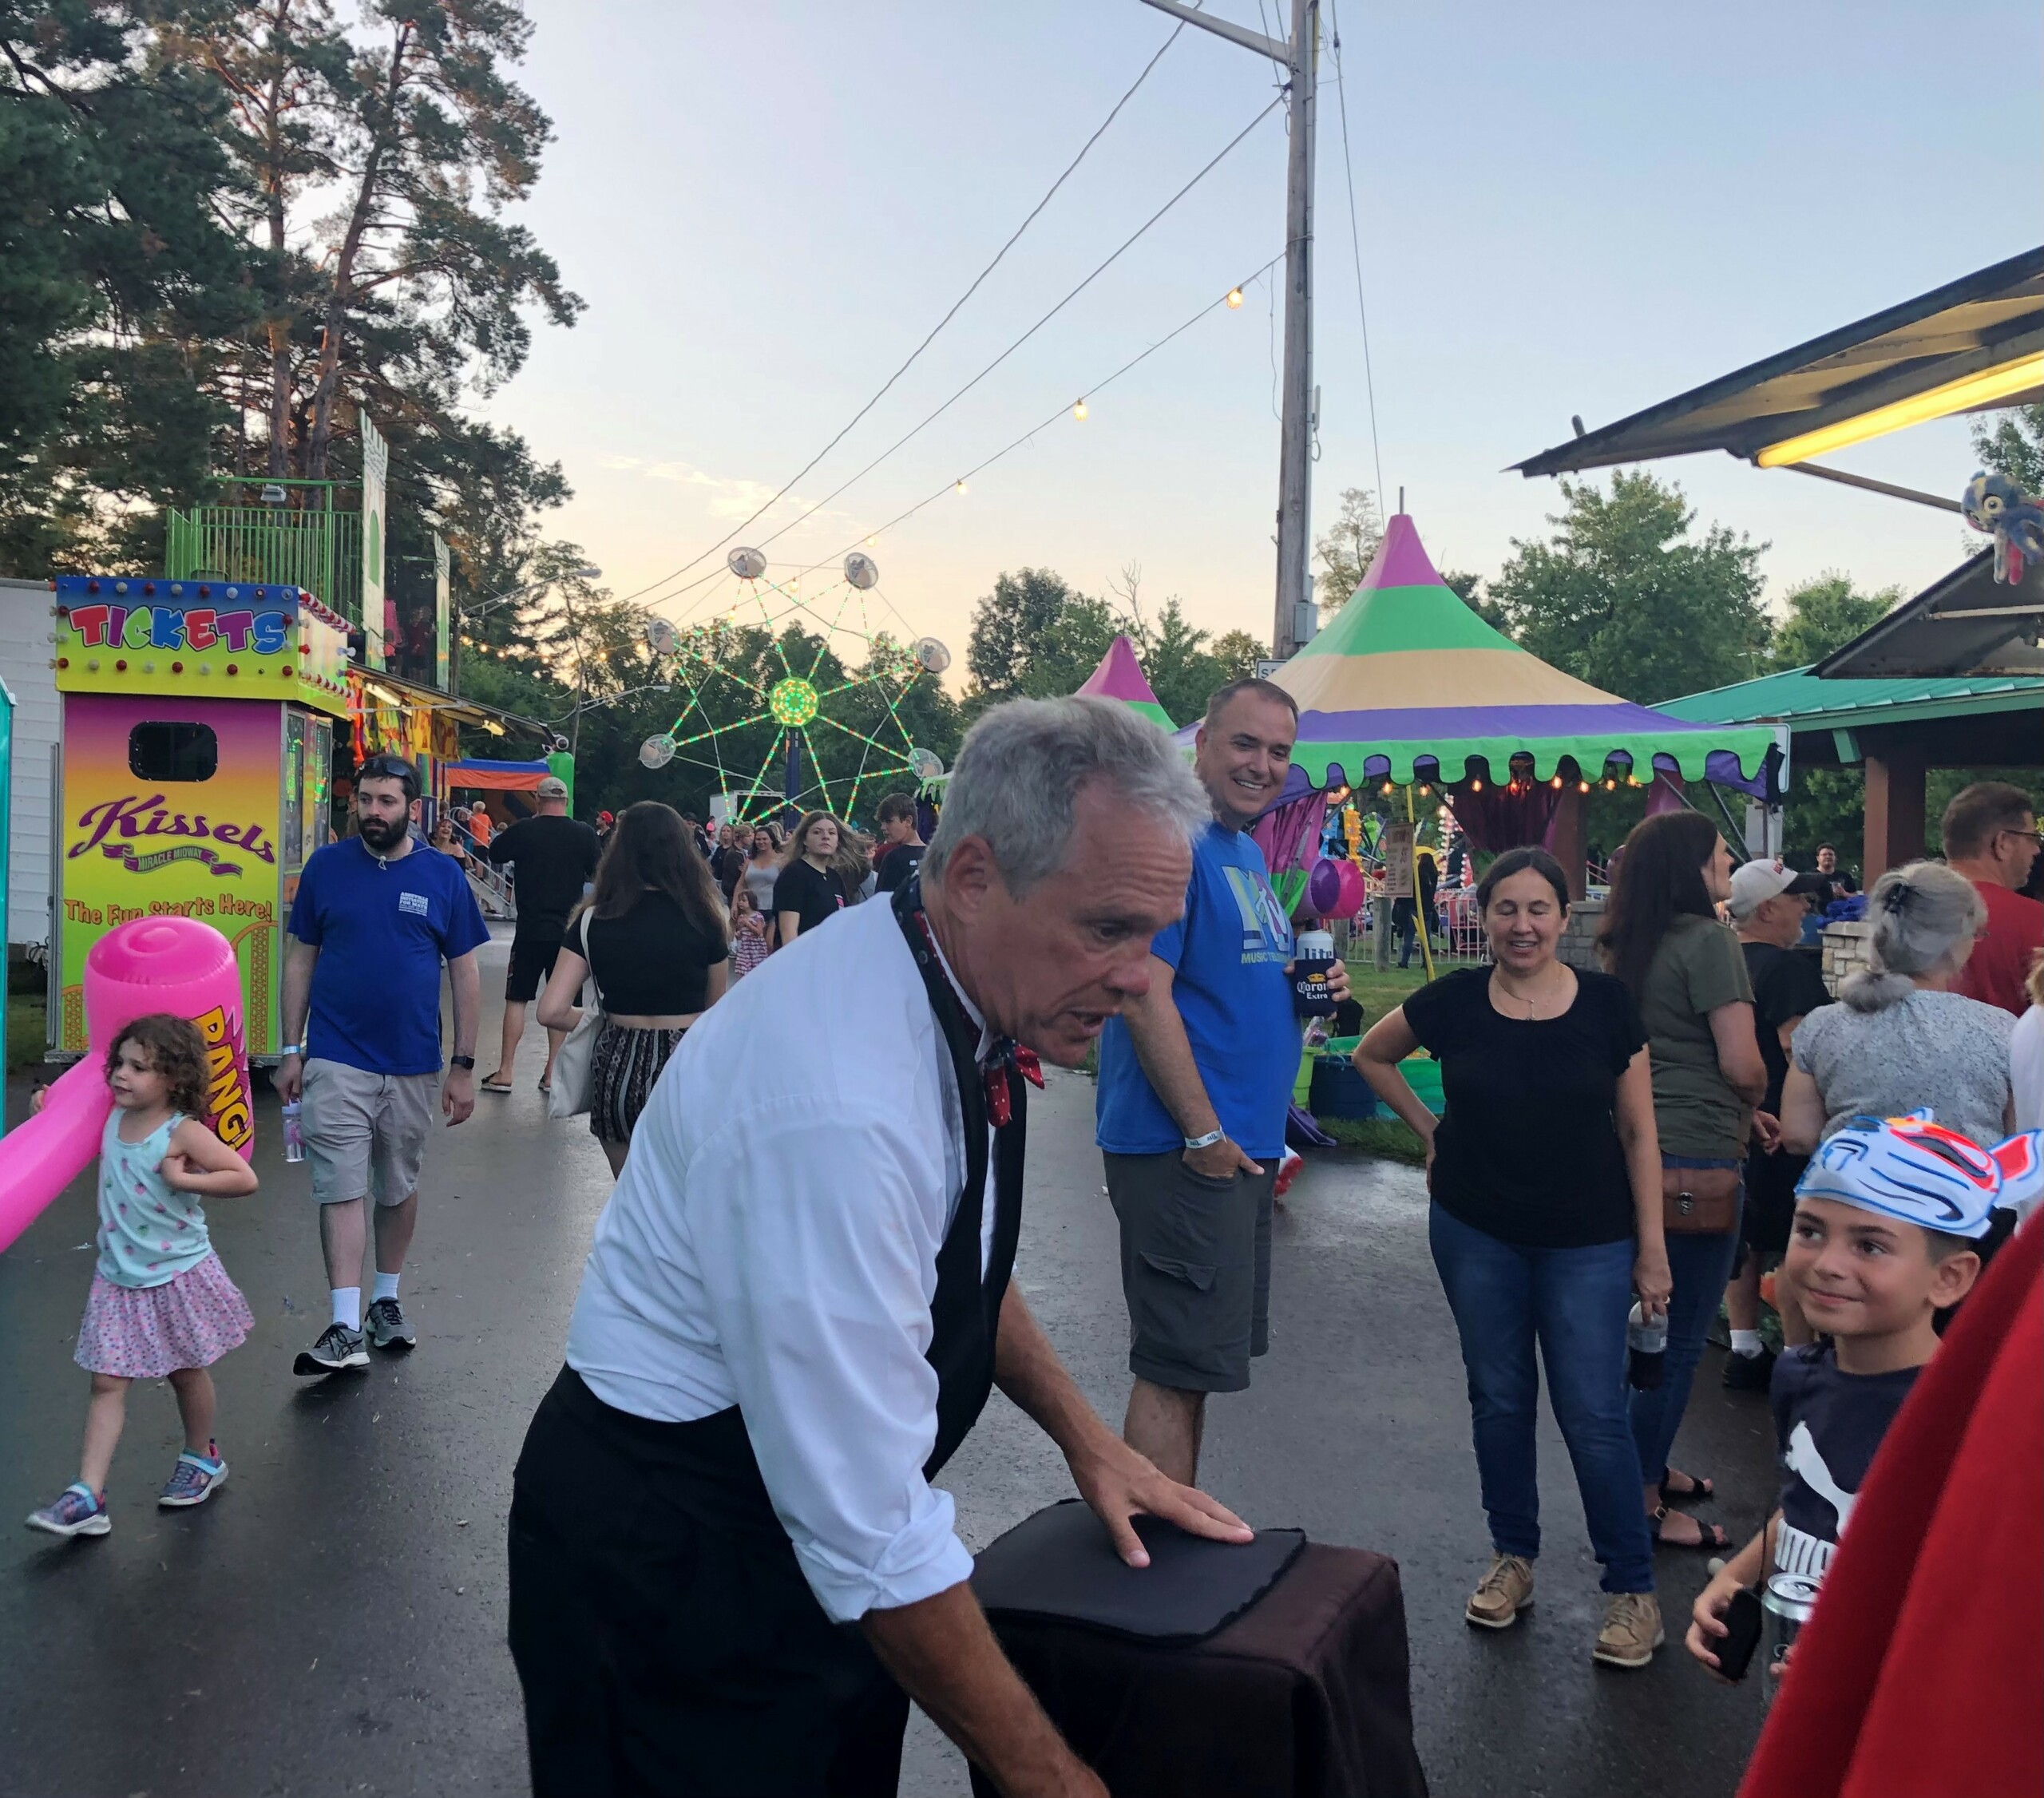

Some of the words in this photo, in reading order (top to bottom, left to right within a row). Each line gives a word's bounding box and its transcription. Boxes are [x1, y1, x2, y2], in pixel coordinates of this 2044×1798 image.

[69, 604, 289, 655] TICKETS
[66, 794, 276, 865] Kissels
[138, 851, 172, 871] MIRACLE
[173, 847, 203, 860] MIDWAY
[65, 898, 102, 925] The
[106, 904, 144, 925] Fun
[149, 896, 215, 918] Starts
[219, 893, 272, 923] Here!
[1222, 865, 1292, 952] MTV
[1241, 951, 1269, 964] MUSIC
[1297, 981, 1327, 995] Coro
